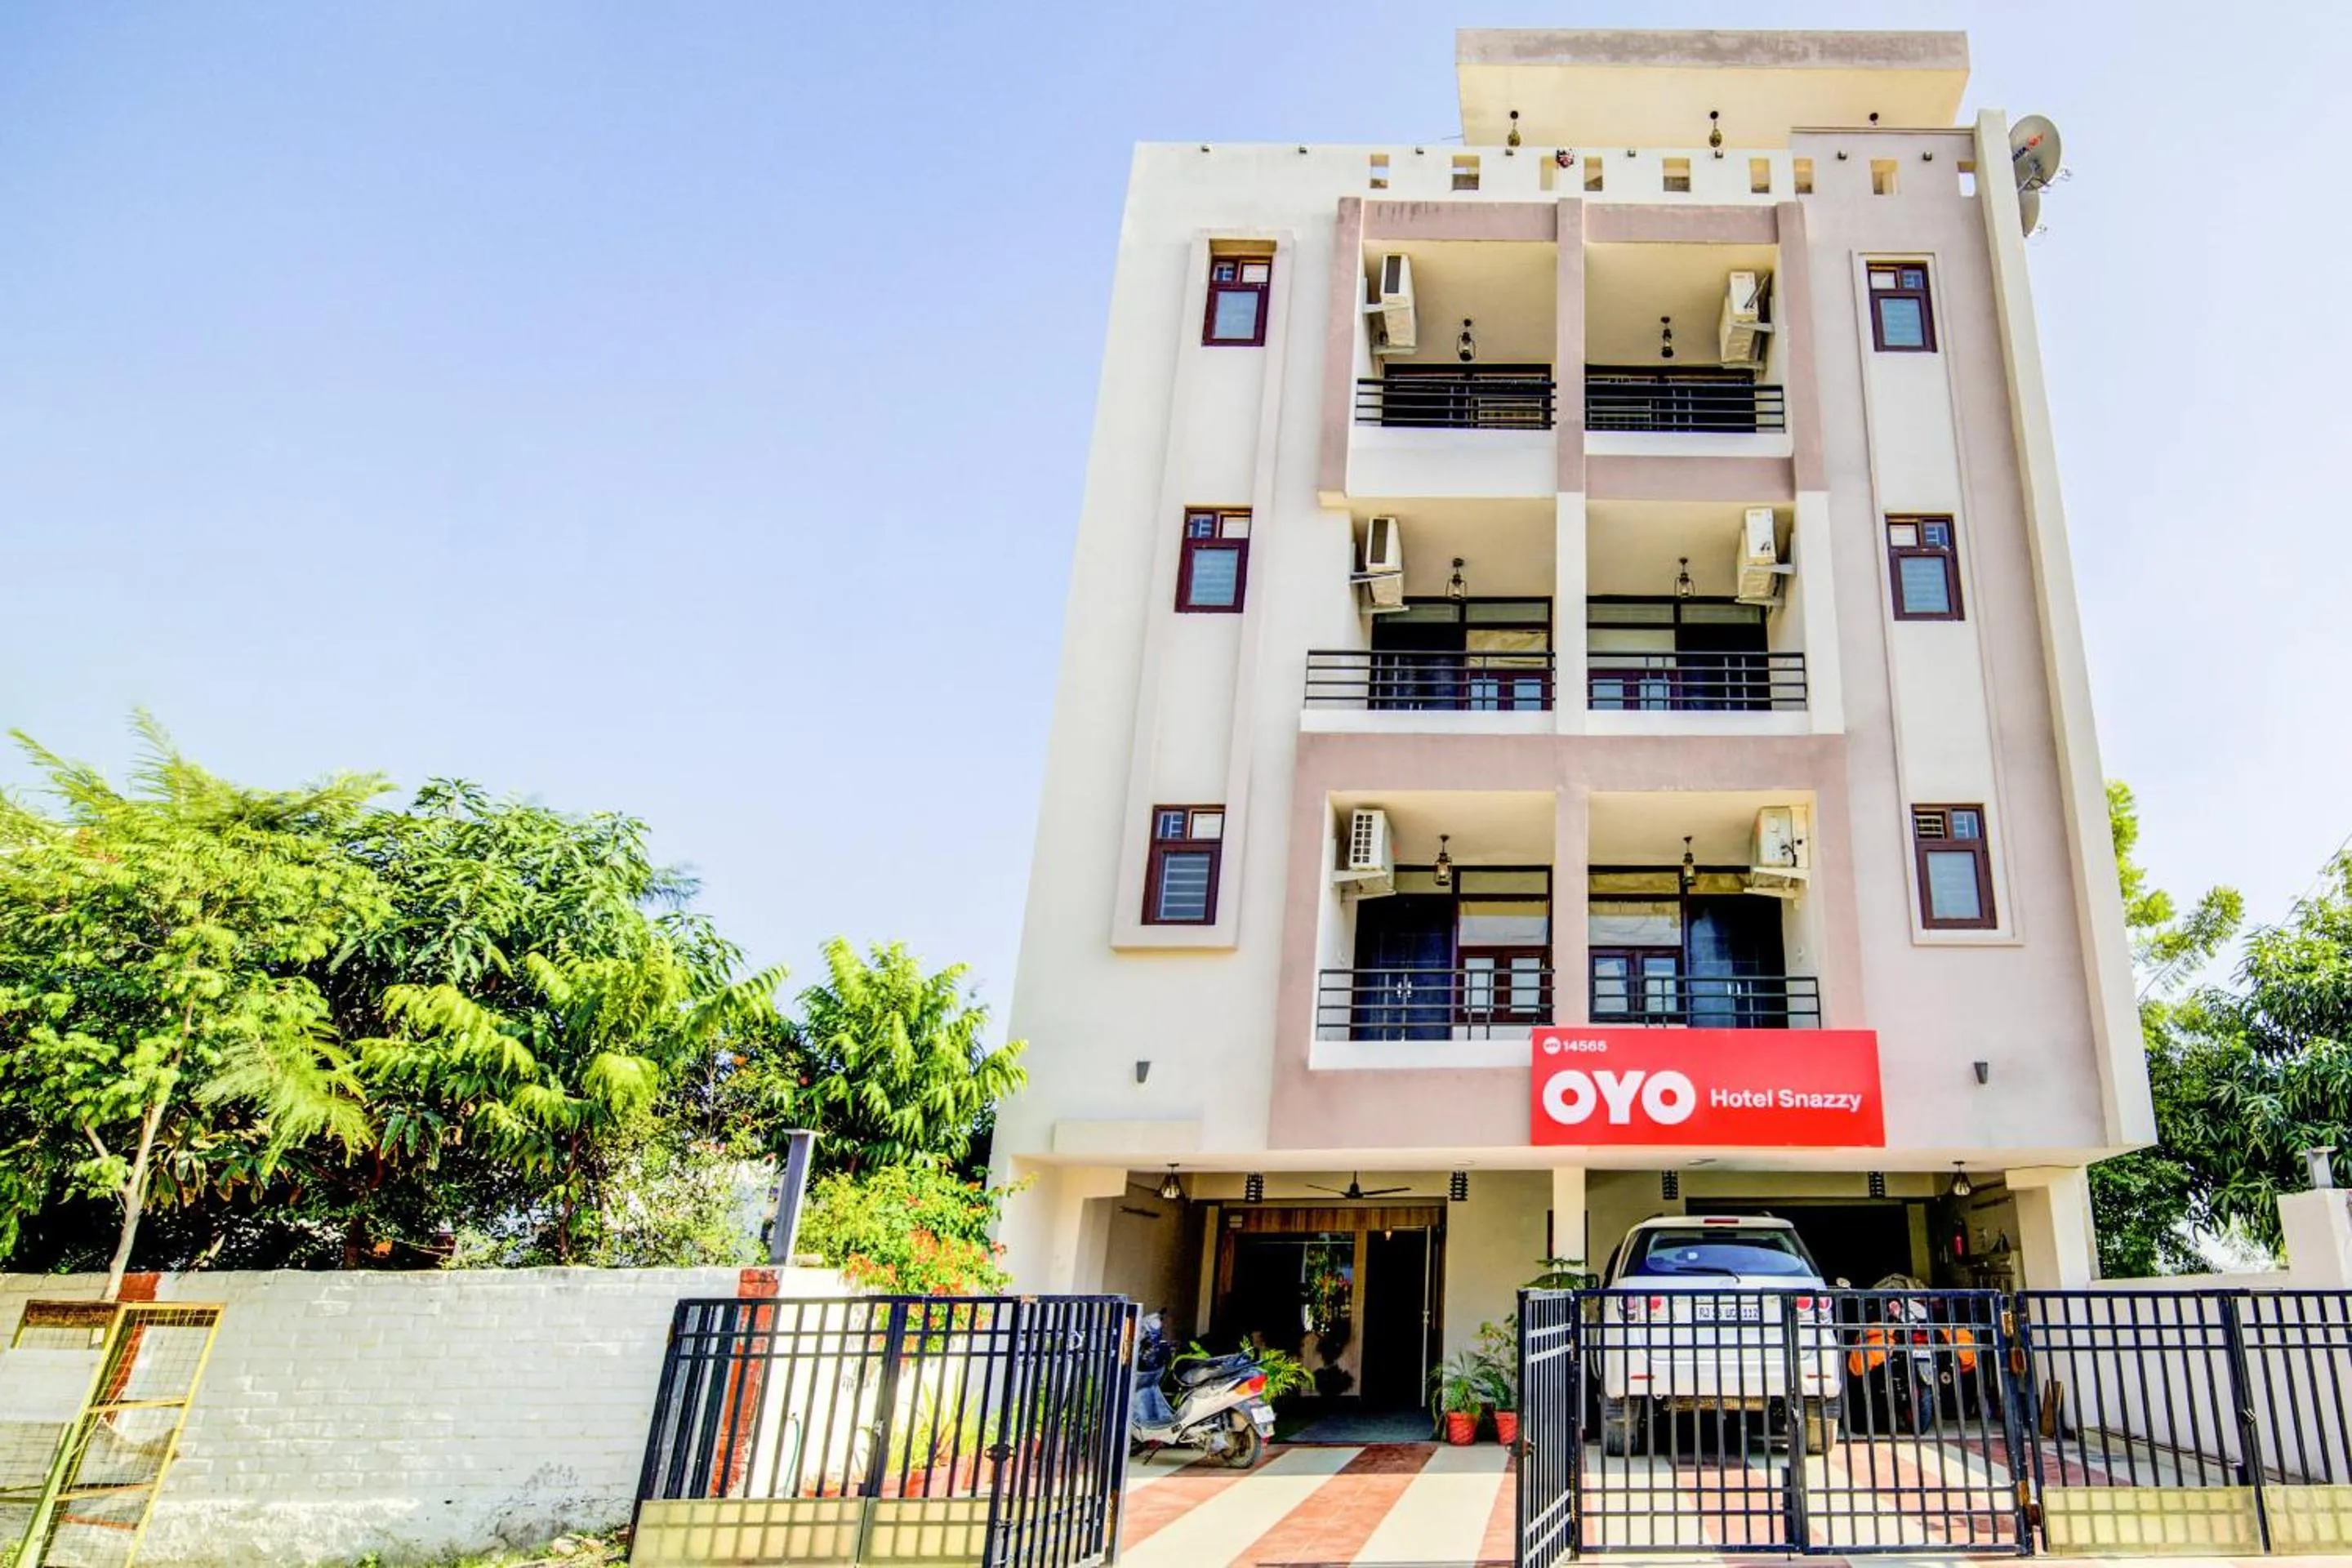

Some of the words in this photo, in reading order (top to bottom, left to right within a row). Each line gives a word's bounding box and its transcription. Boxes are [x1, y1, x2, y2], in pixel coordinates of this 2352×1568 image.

[1542, 1069, 1696, 1125] OYO
[1710, 1088, 1773, 1108] Hotel
[1778, 1089, 1862, 1113] Snazzy
